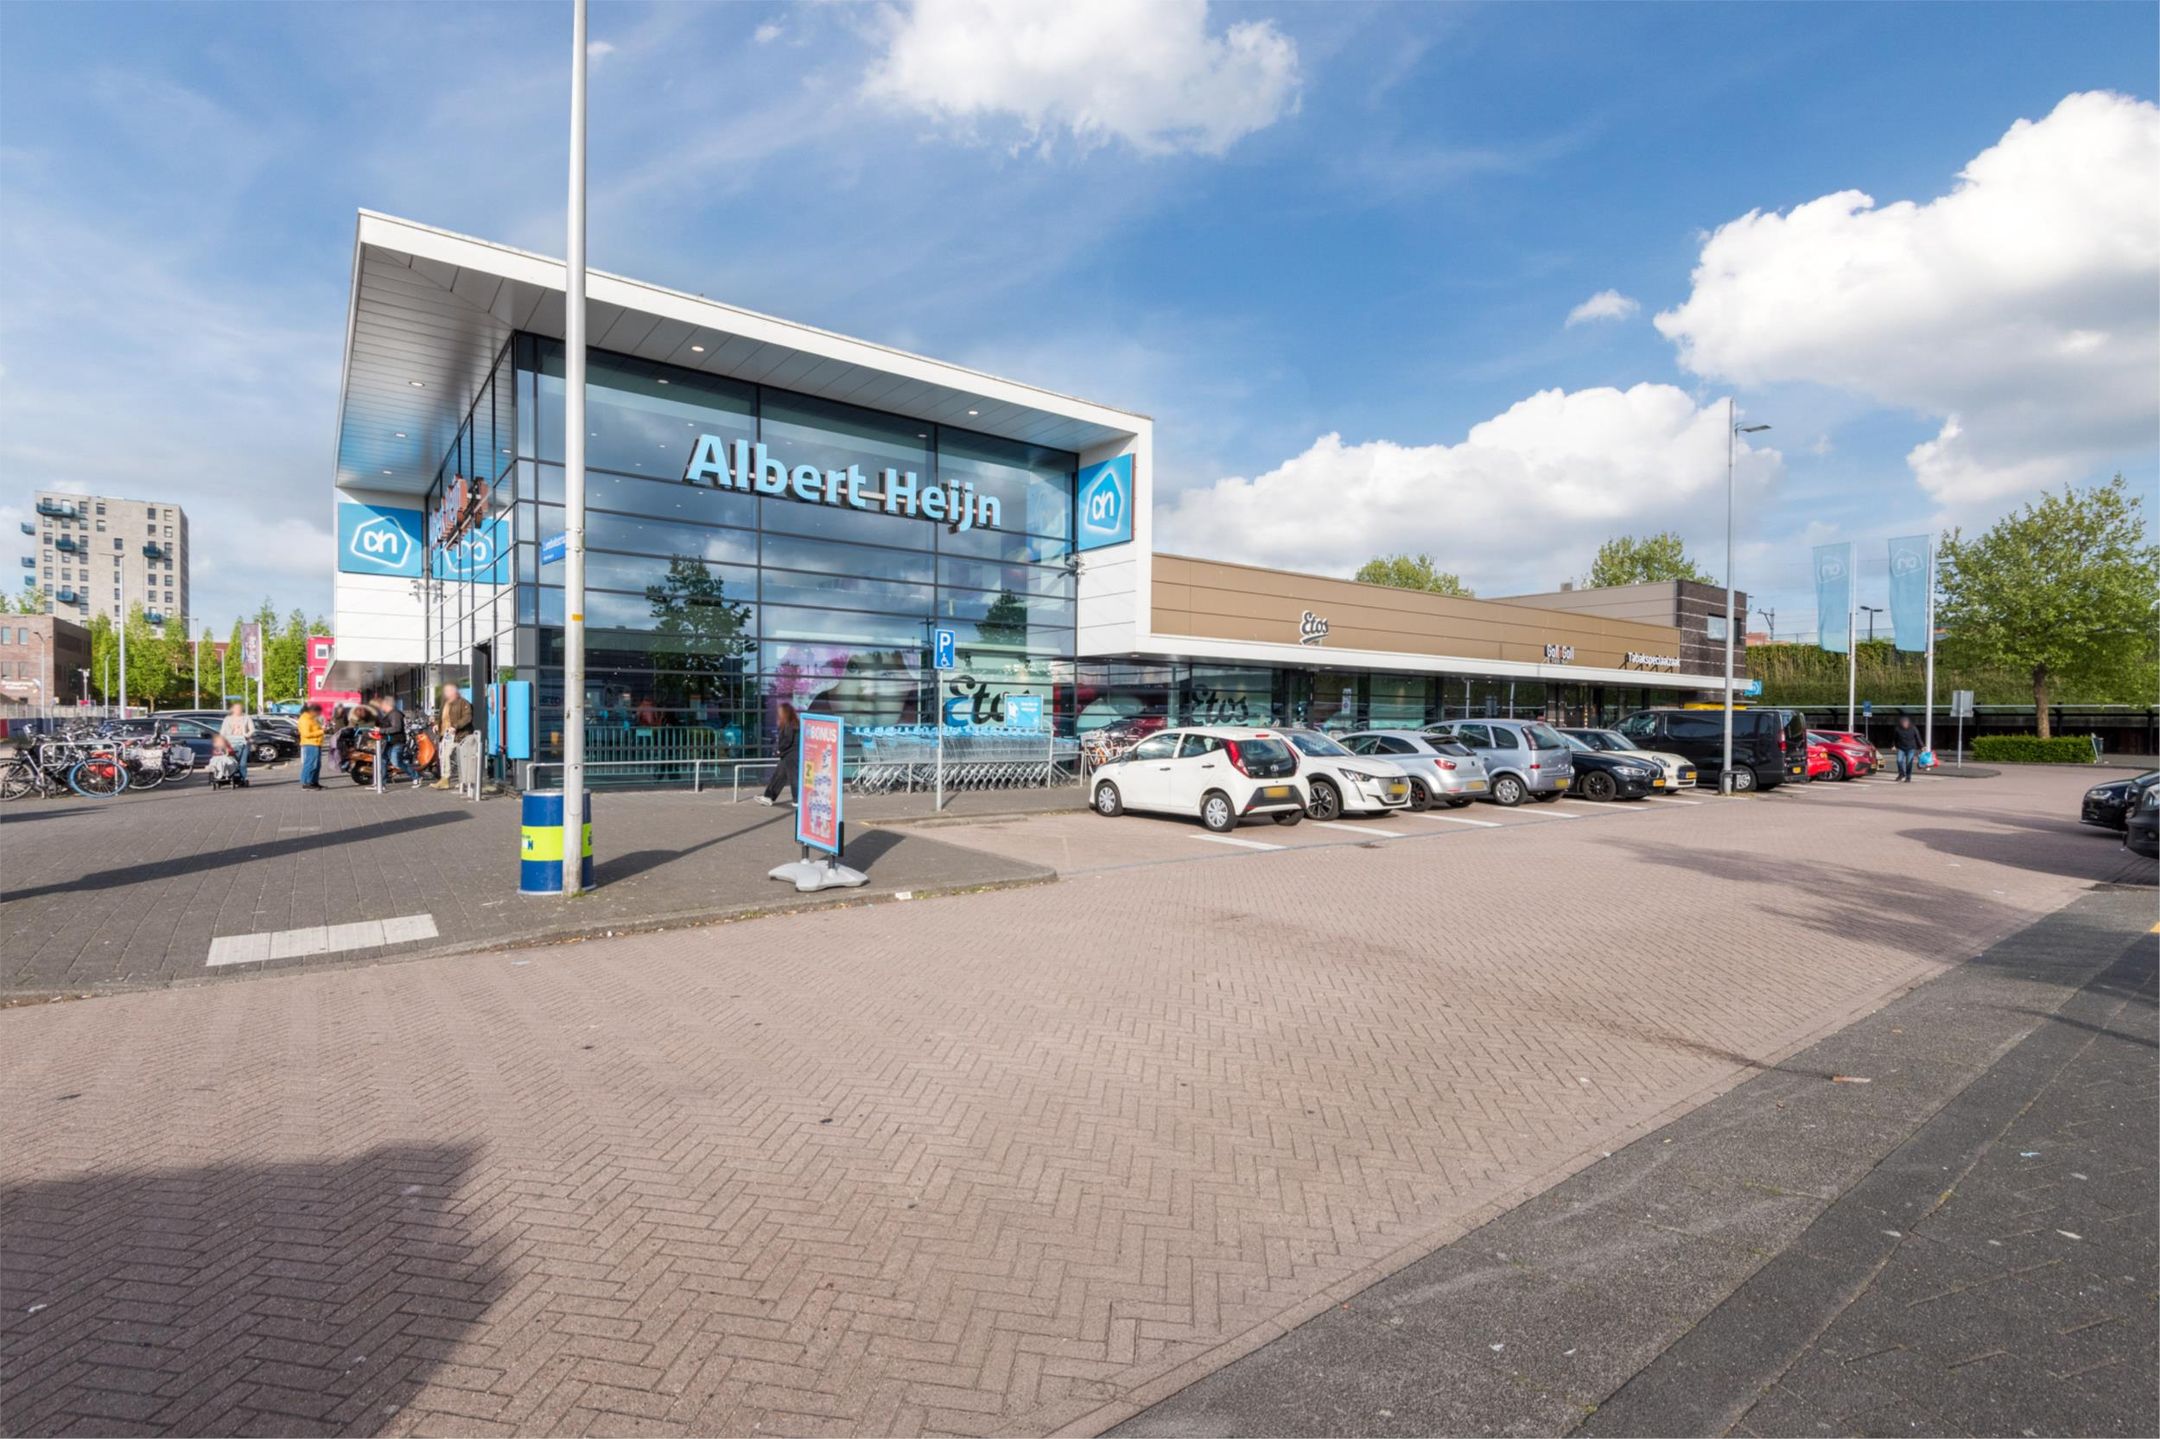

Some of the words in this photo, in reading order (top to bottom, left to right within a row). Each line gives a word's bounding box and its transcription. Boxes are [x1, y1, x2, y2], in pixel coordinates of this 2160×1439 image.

[684, 434, 866, 507] Albert
[885, 468, 1002, 533] Heijn
[1301, 611, 1329, 635] Etos
[939, 632, 951, 653] P
[811, 725, 837, 744] BONUS
